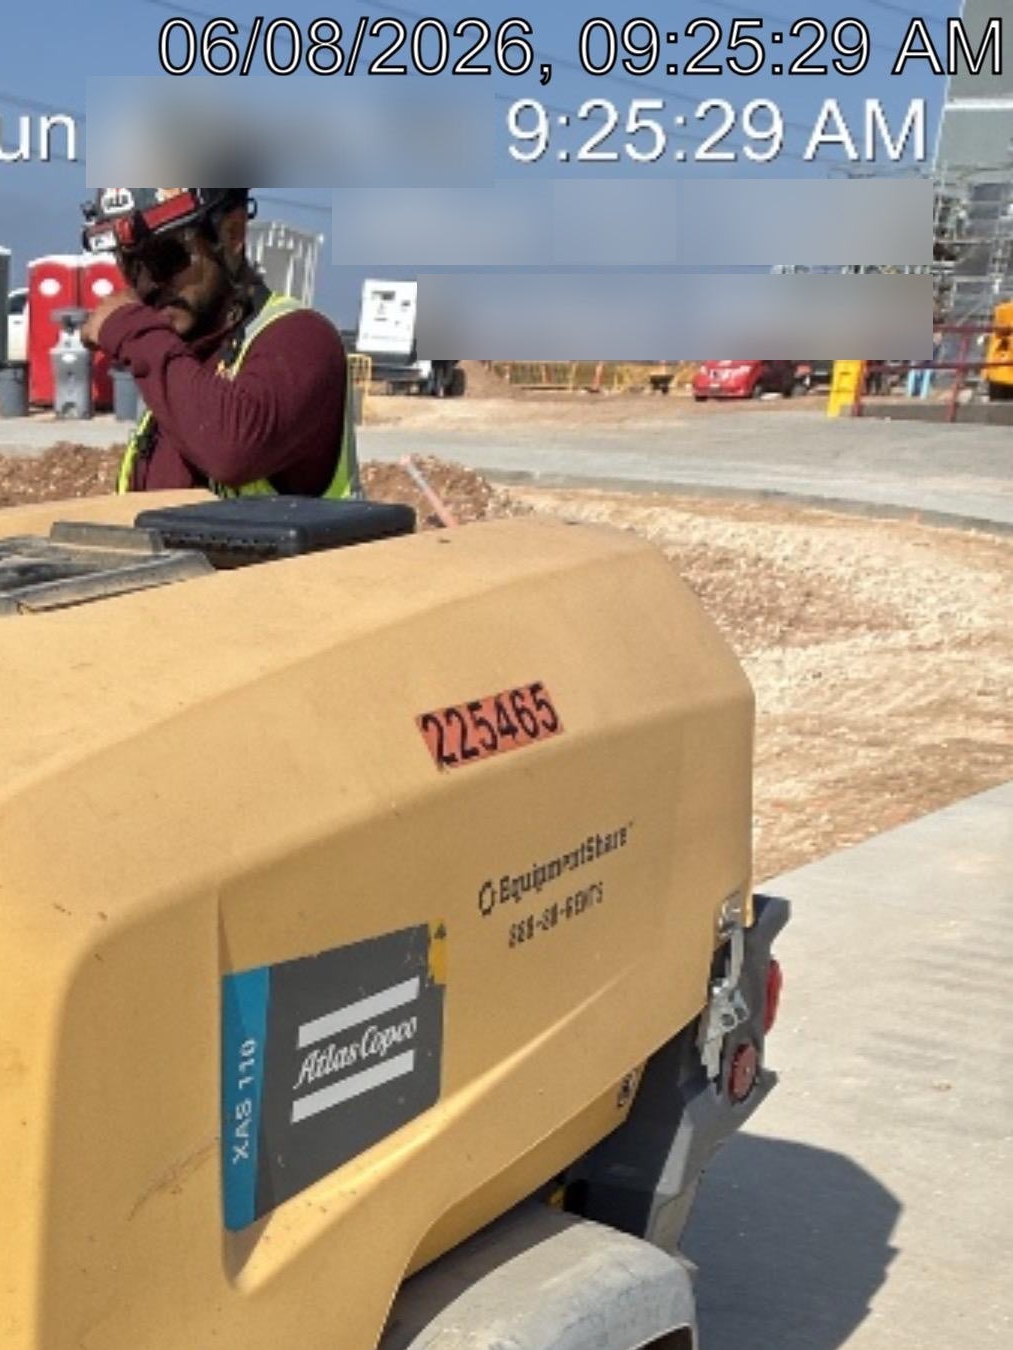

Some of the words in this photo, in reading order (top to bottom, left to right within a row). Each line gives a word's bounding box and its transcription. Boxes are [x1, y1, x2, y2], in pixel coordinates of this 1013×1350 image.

[421, 682, 559, 771] 225465
[238, 1037, 257, 1089] 110
[292, 1041, 362, 1090] Atlas
[360, 1016, 418, 1058] Copco
[232, 1099, 253, 1165] XAS
